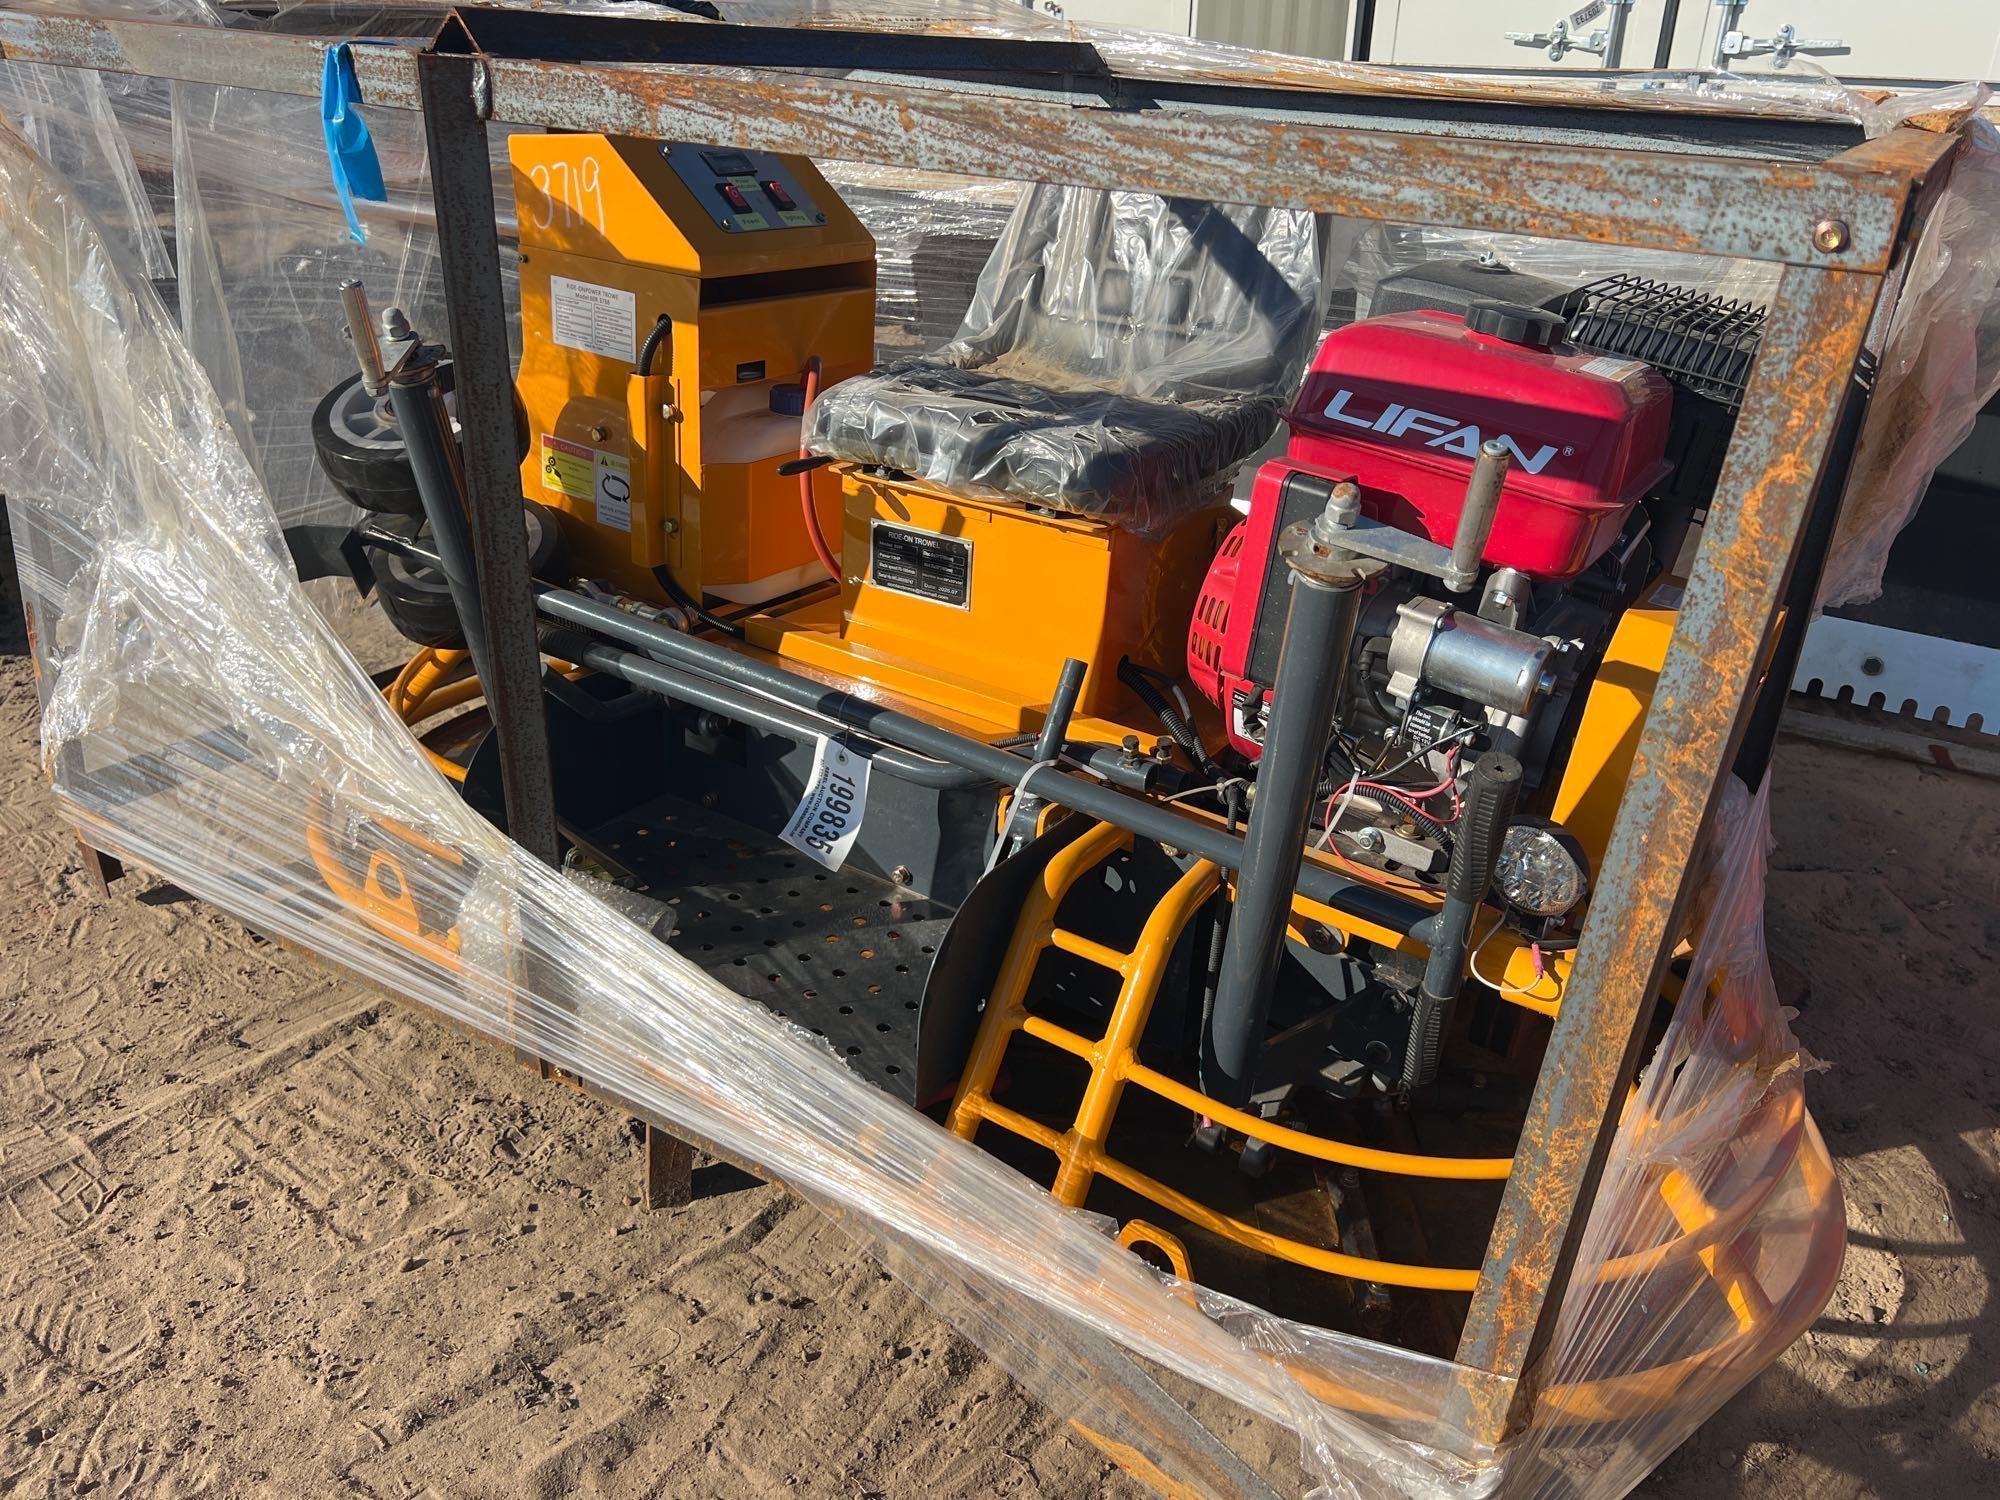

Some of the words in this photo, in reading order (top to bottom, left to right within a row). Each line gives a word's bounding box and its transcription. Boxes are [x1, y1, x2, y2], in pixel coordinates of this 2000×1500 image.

[530, 157, 605, 236] 3719
[1323, 389, 1559, 475] LIFAN
[914, 537, 940, 549] TROWEL
[797, 812, 813, 838] COMPANY
[805, 773, 855, 855] 199835
[812, 785, 826, 813] AUCTION
